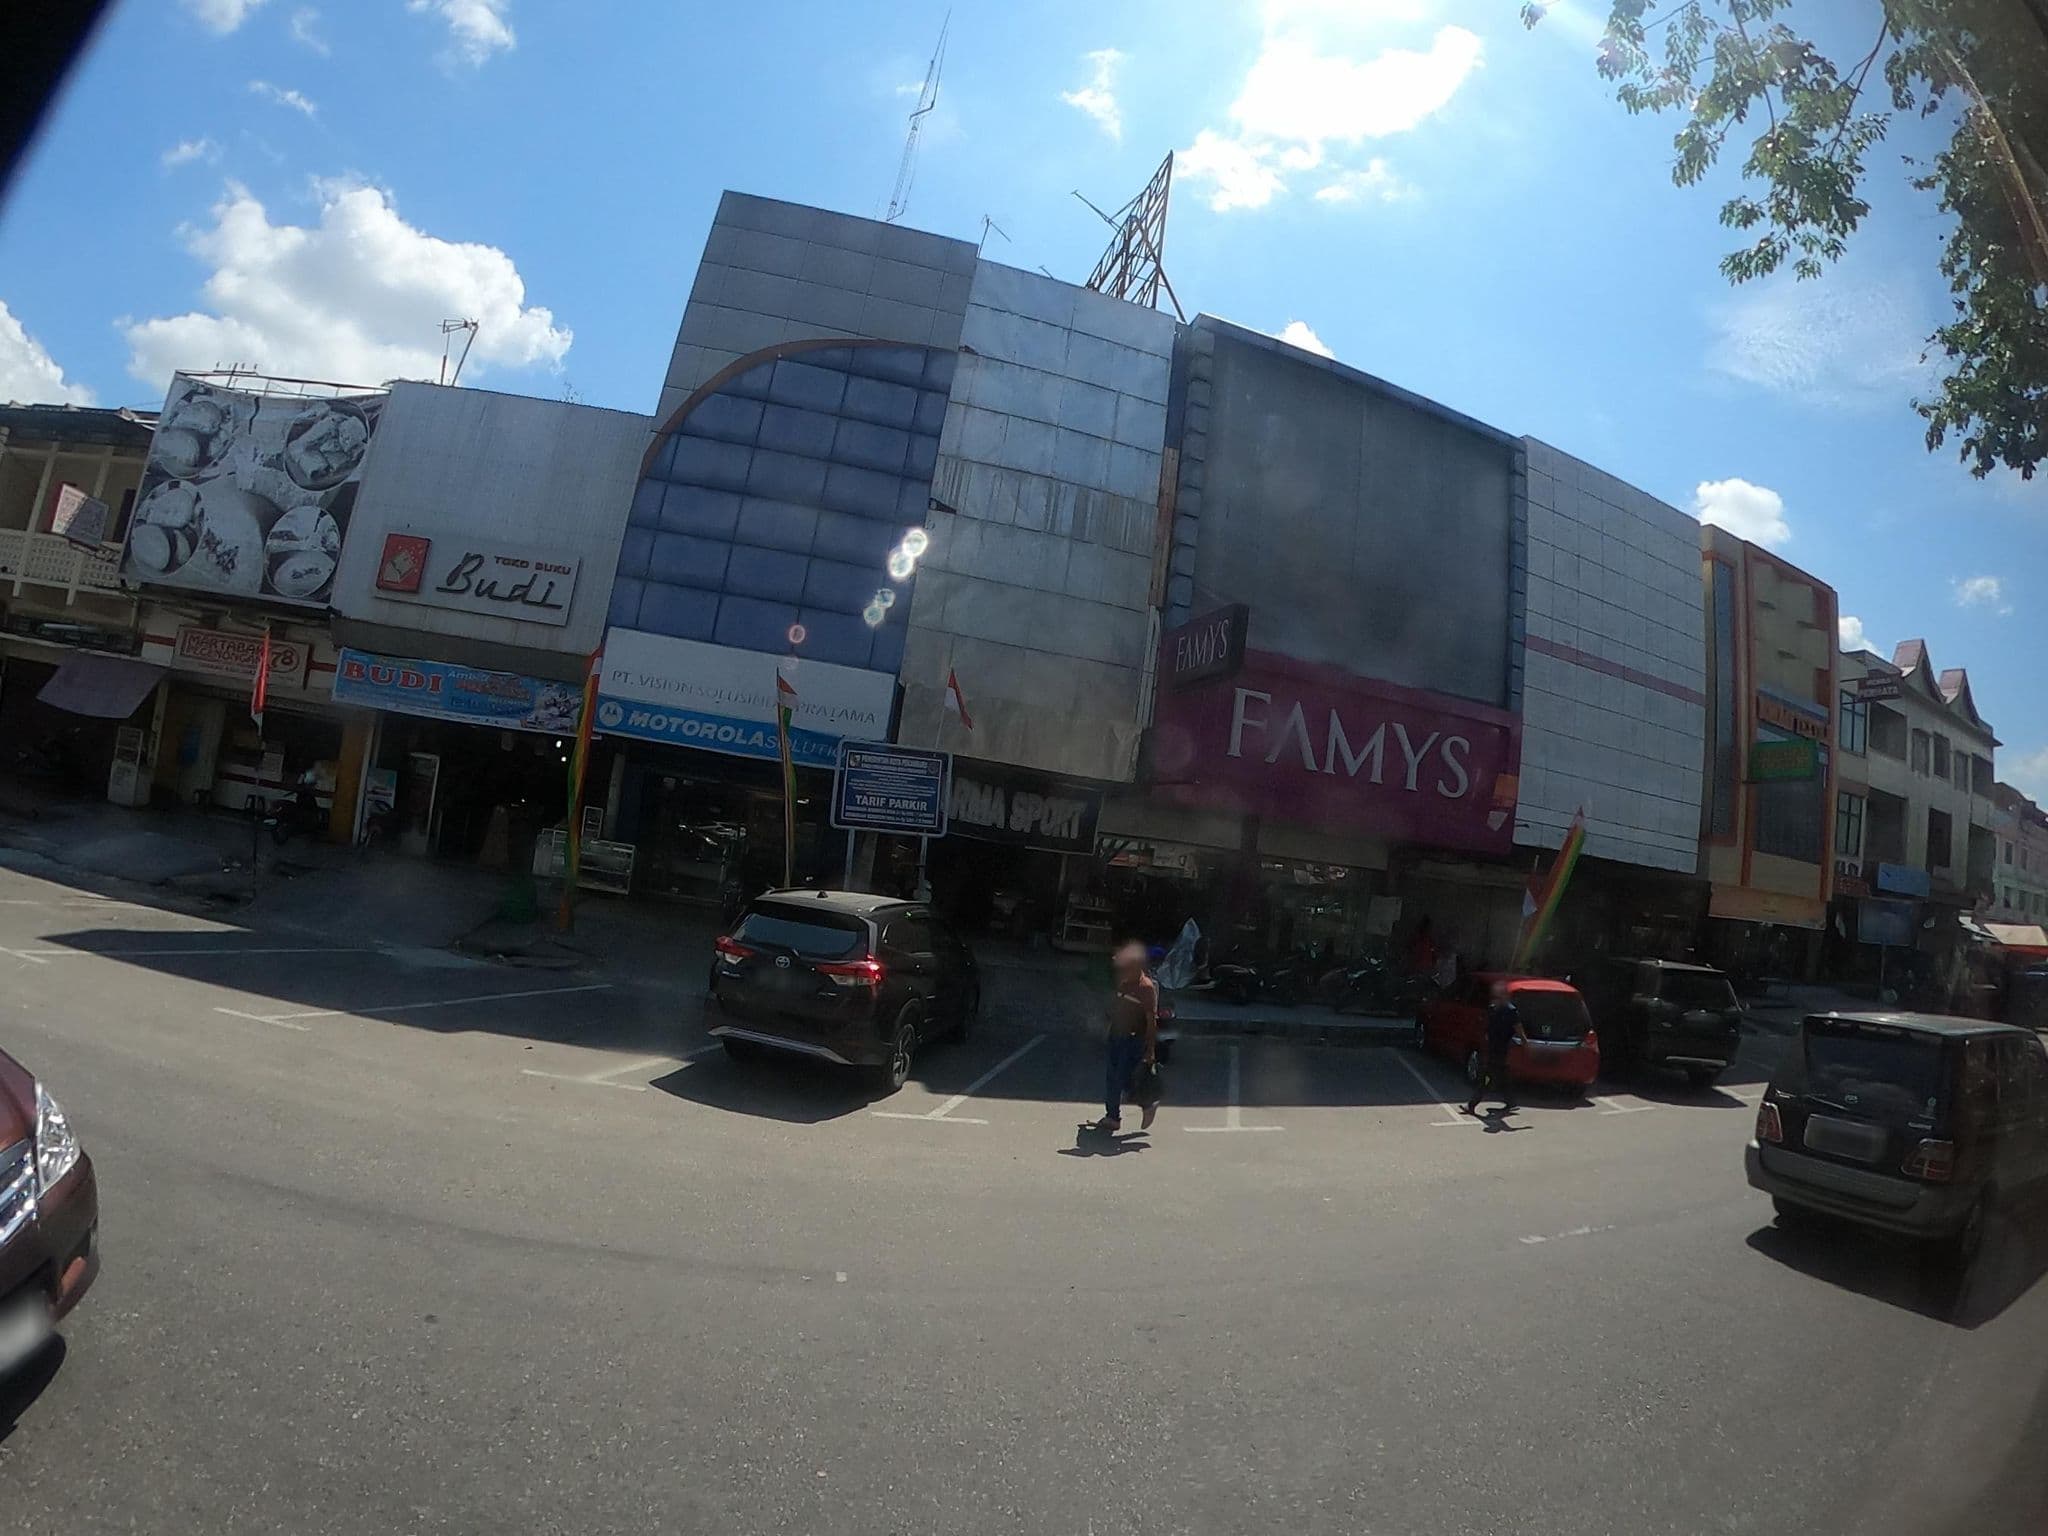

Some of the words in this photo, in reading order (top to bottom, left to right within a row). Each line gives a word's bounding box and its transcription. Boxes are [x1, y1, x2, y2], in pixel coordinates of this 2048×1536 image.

[436, 552, 562, 609] Budi
[494, 555, 529, 569] TOKO
[534, 562, 572, 576] BUKU
[271, 647, 294, 668] 78
[1176, 618, 1229, 673] FAMYS
[342, 660, 443, 694] BUDI
[611, 670, 634, 685] PT.
[638, 674, 693, 695] VISION
[795, 702, 876, 725] PRATAMA
[627, 710, 766, 748] MOTOROLA
[1224, 686, 1471, 799] FAMYS
[854, 794, 887, 807] TARIF
[888, 798, 929, 812] PARKIR
[1009, 791, 1088, 840] SPORT
